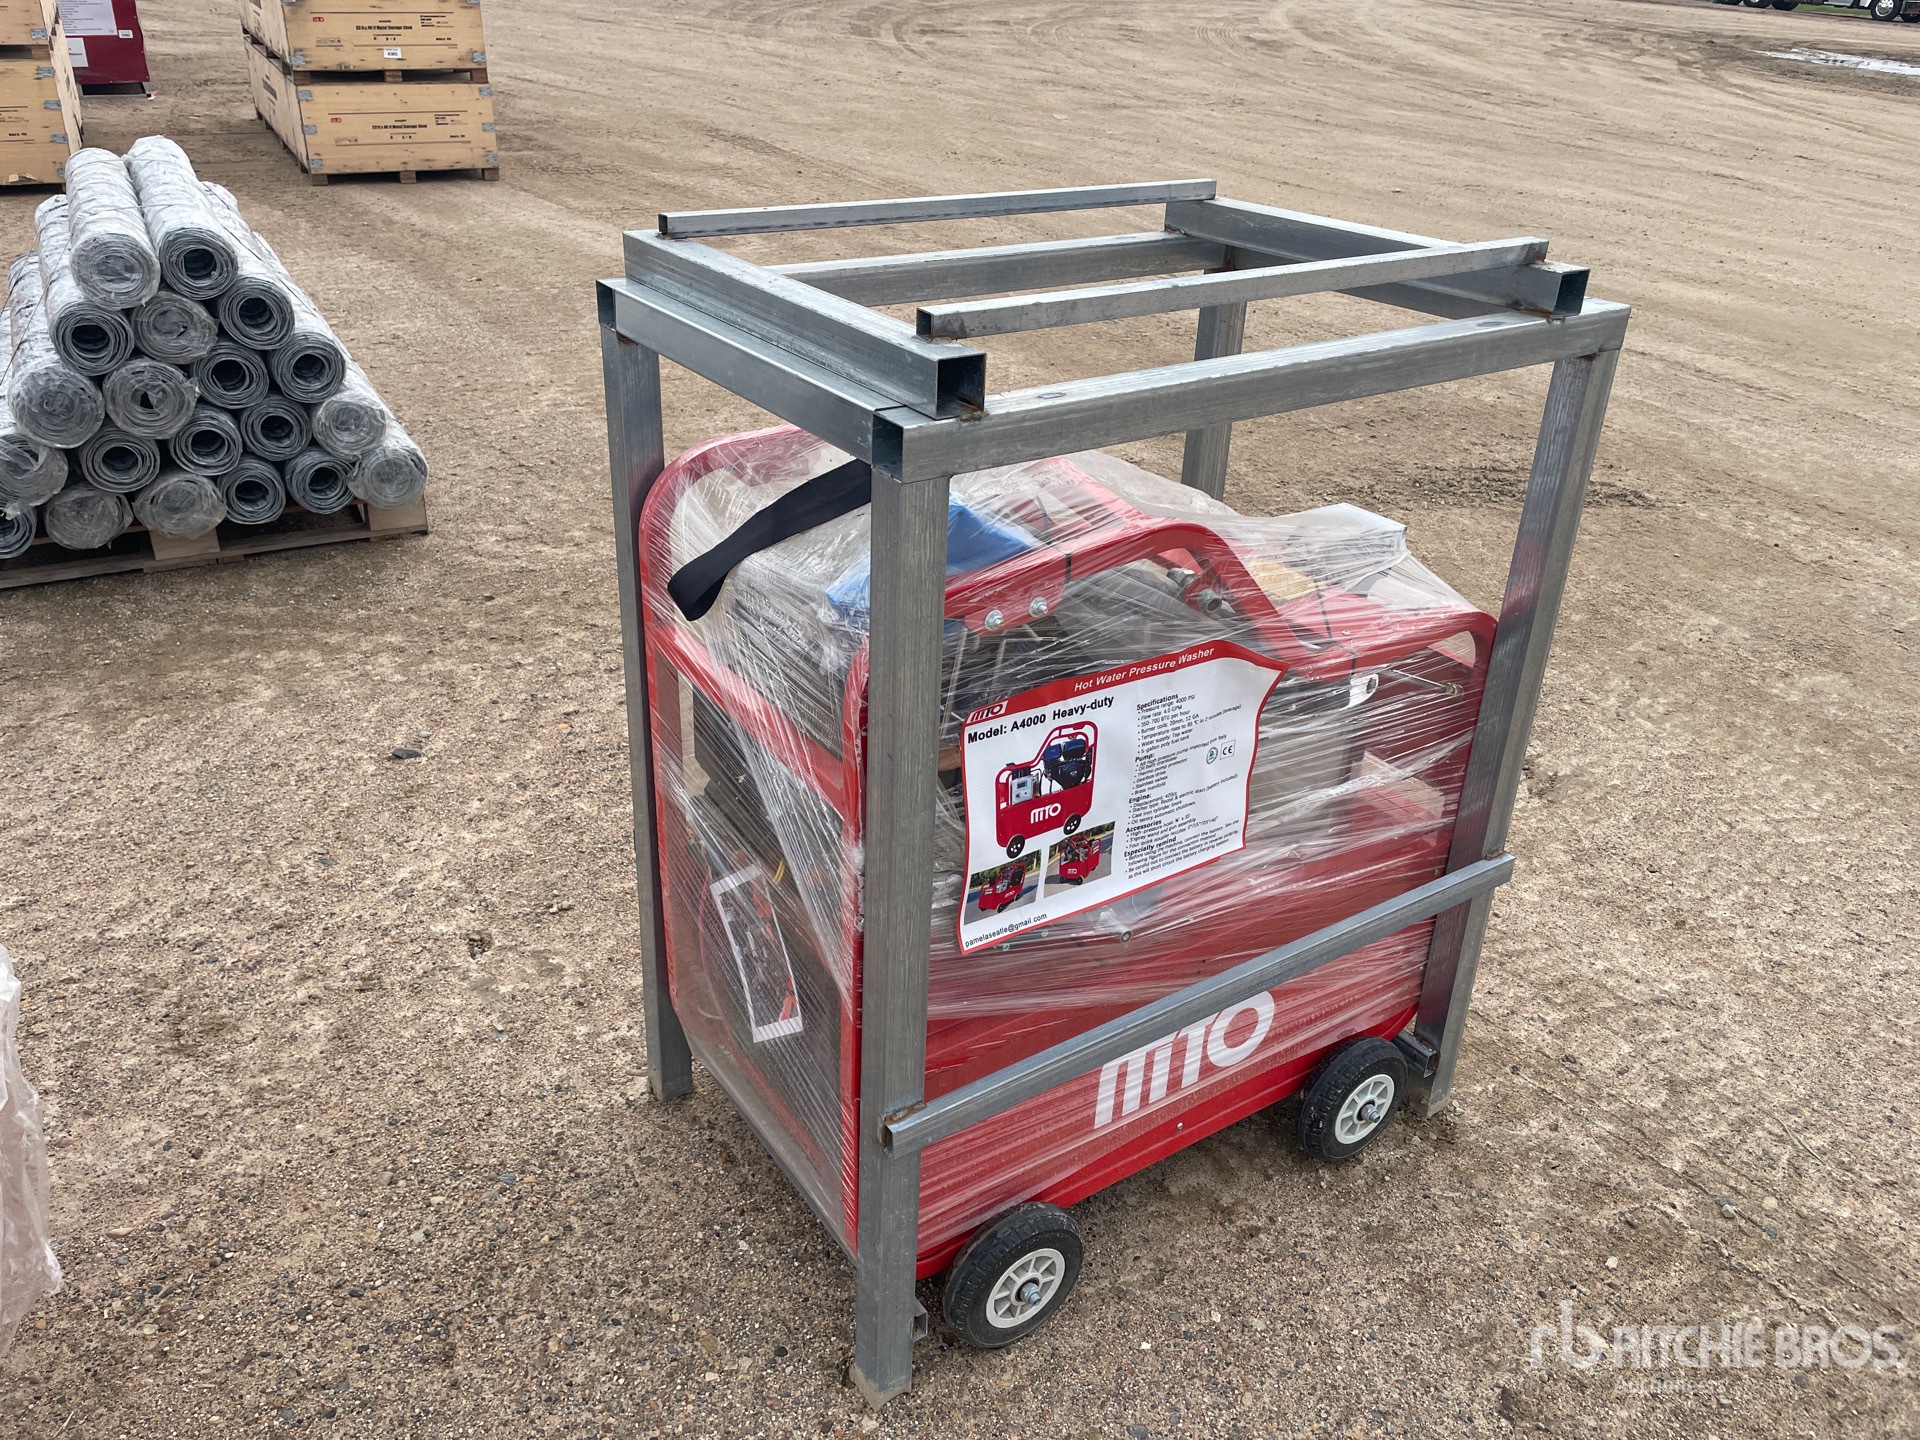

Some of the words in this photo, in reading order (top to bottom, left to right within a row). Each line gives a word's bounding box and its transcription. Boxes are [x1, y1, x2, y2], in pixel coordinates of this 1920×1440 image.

[1074, 680, 1094, 692] Hot
[1096, 671, 1125, 686] Water
[1129, 658, 1176, 676] Pressure
[1178, 648, 1214, 664] Washer
[1136, 694, 1179, 710] Specifications
[968, 724, 1007, 744] Model:
[1010, 712, 1046, 732] A4000
[1052, 696, 1114, 720] Heavy-duty
[1141, 726, 1155, 734] Burner
[1141, 729, 1169, 740] Temperature
[1190, 741, 1209, 751] imported
[1135, 753, 1155, 762] Pump:
[1155, 765, 1167, 773] pump
[1168, 758, 1188, 768] protector
[1135, 779, 1154, 789] Stainless
[1128, 794, 1152, 804] Engine:
[1153, 804, 1170, 813] cylinder
[1154, 808, 1175, 818] automatic
[1176, 801, 1196, 811] shutdown
[1125, 819, 1162, 833] Accessories
[1124, 845, 1154, 857] Especially
[1156, 836, 1177, 847] remind
[1128, 857, 1148, 866] following
[1177, 839, 1199, 849] connection
[1183, 850, 1197, 859] battery
[1198, 844, 1215, 853] charging
[1135, 861, 1150, 870] careful
[1164, 850, 1181, 860] connect
[1189, 842, 1204, 851] battery
